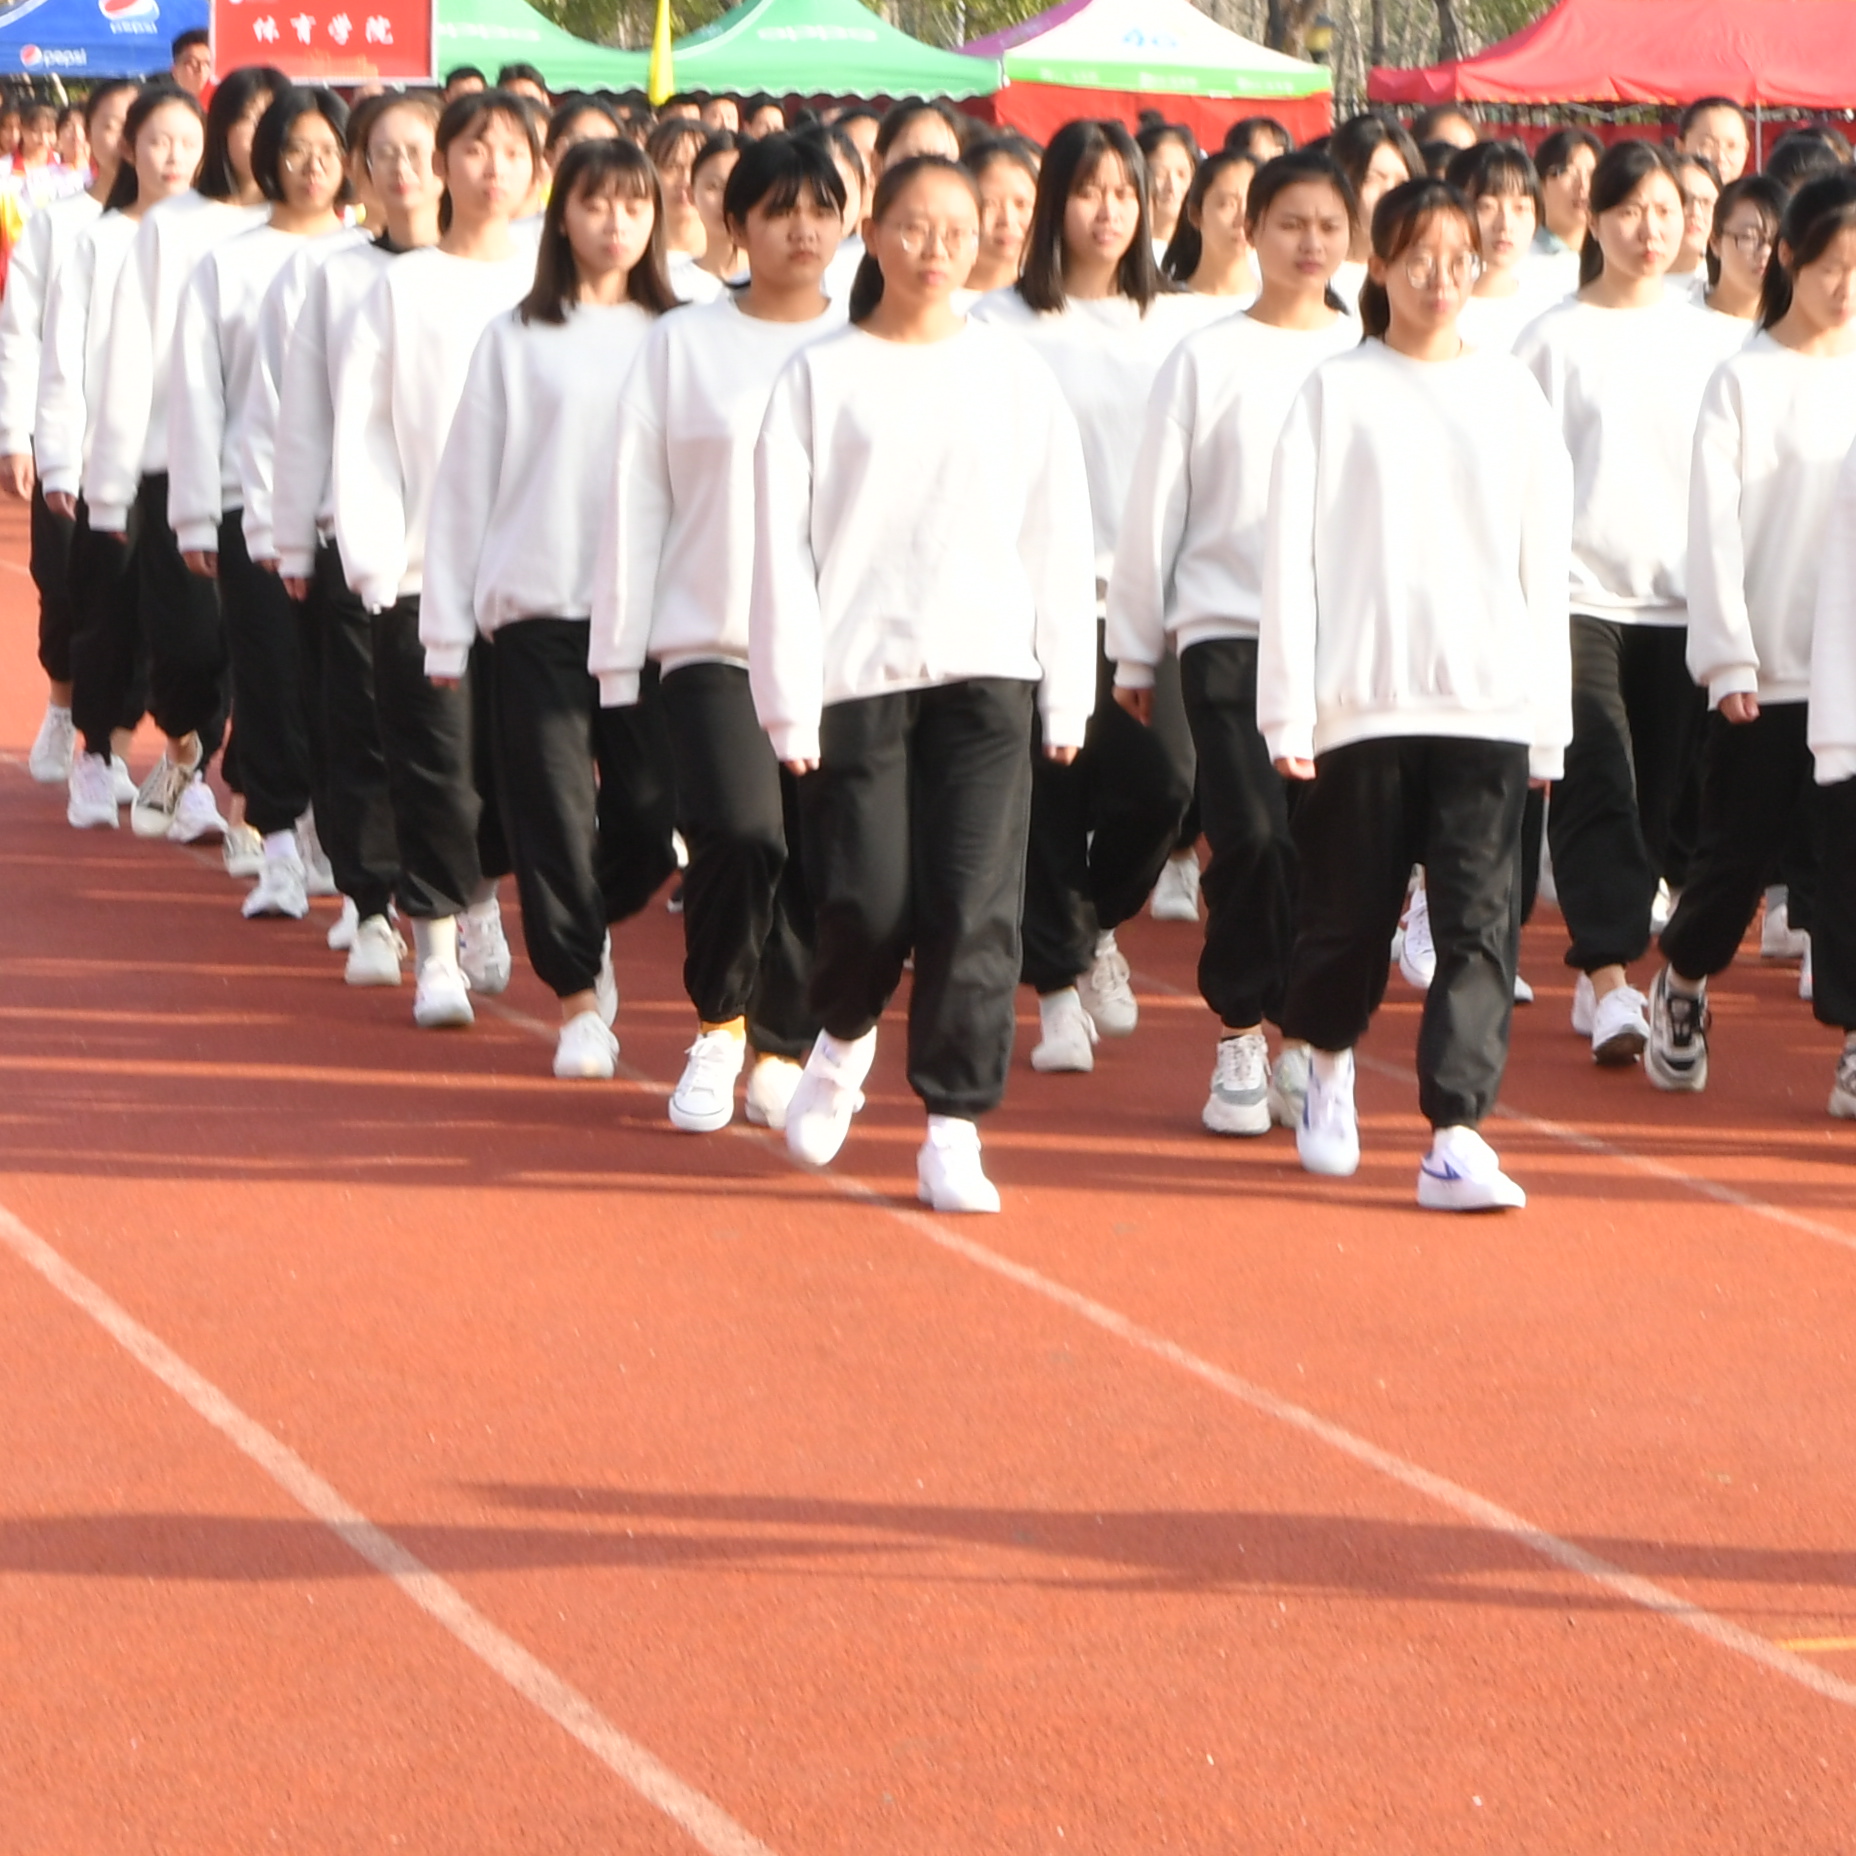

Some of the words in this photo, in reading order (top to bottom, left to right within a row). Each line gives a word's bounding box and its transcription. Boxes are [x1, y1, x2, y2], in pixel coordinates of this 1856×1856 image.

[252, 11, 394, 46] 体育学院
[43, 47, 88, 68] pepsi
